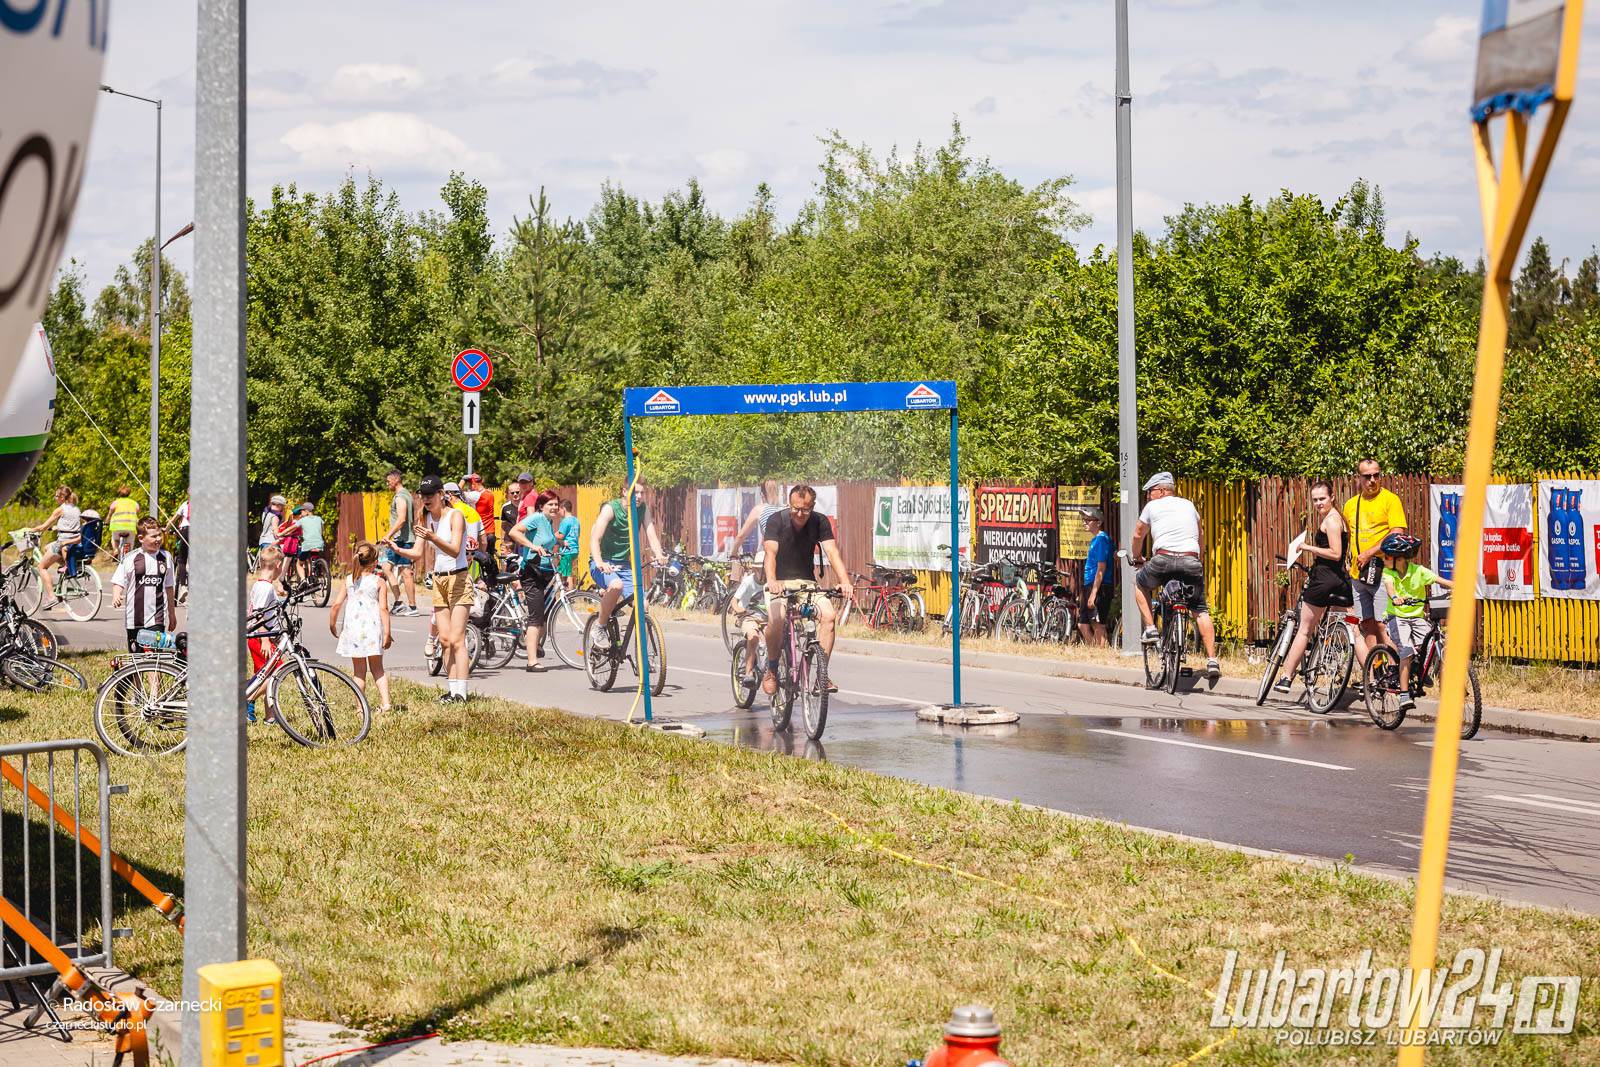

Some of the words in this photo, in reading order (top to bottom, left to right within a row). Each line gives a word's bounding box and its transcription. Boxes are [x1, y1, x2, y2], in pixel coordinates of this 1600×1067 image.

[743, 389, 847, 406] www.pgk.lub.pl
[980, 493, 1053, 523] SPRZEDAM
[983, 530, 1048, 548] NIERUCHOMOŚĆ
[138, 575, 163, 587] Jeep
